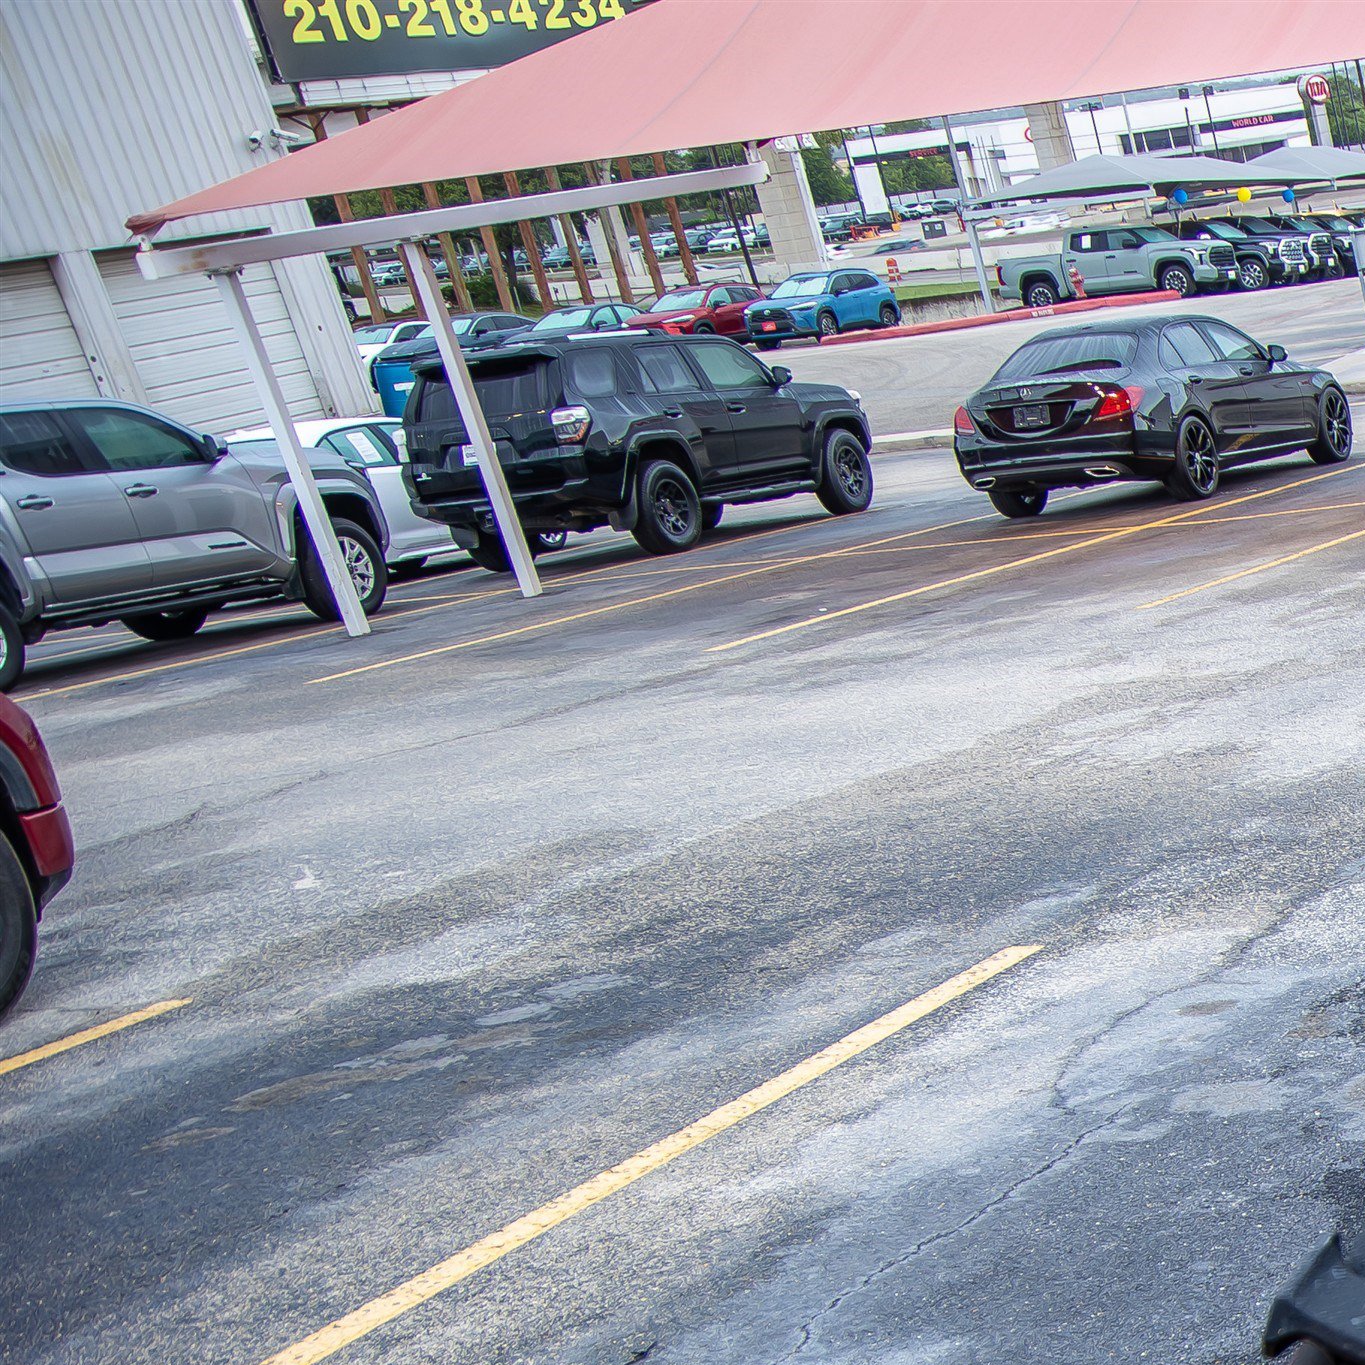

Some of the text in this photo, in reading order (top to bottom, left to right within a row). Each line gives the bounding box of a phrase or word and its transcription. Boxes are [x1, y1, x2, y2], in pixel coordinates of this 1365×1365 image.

[283, 0, 625, 43] 210-218-4234
[1231, 114, 1275, 128] WORLD CAR
